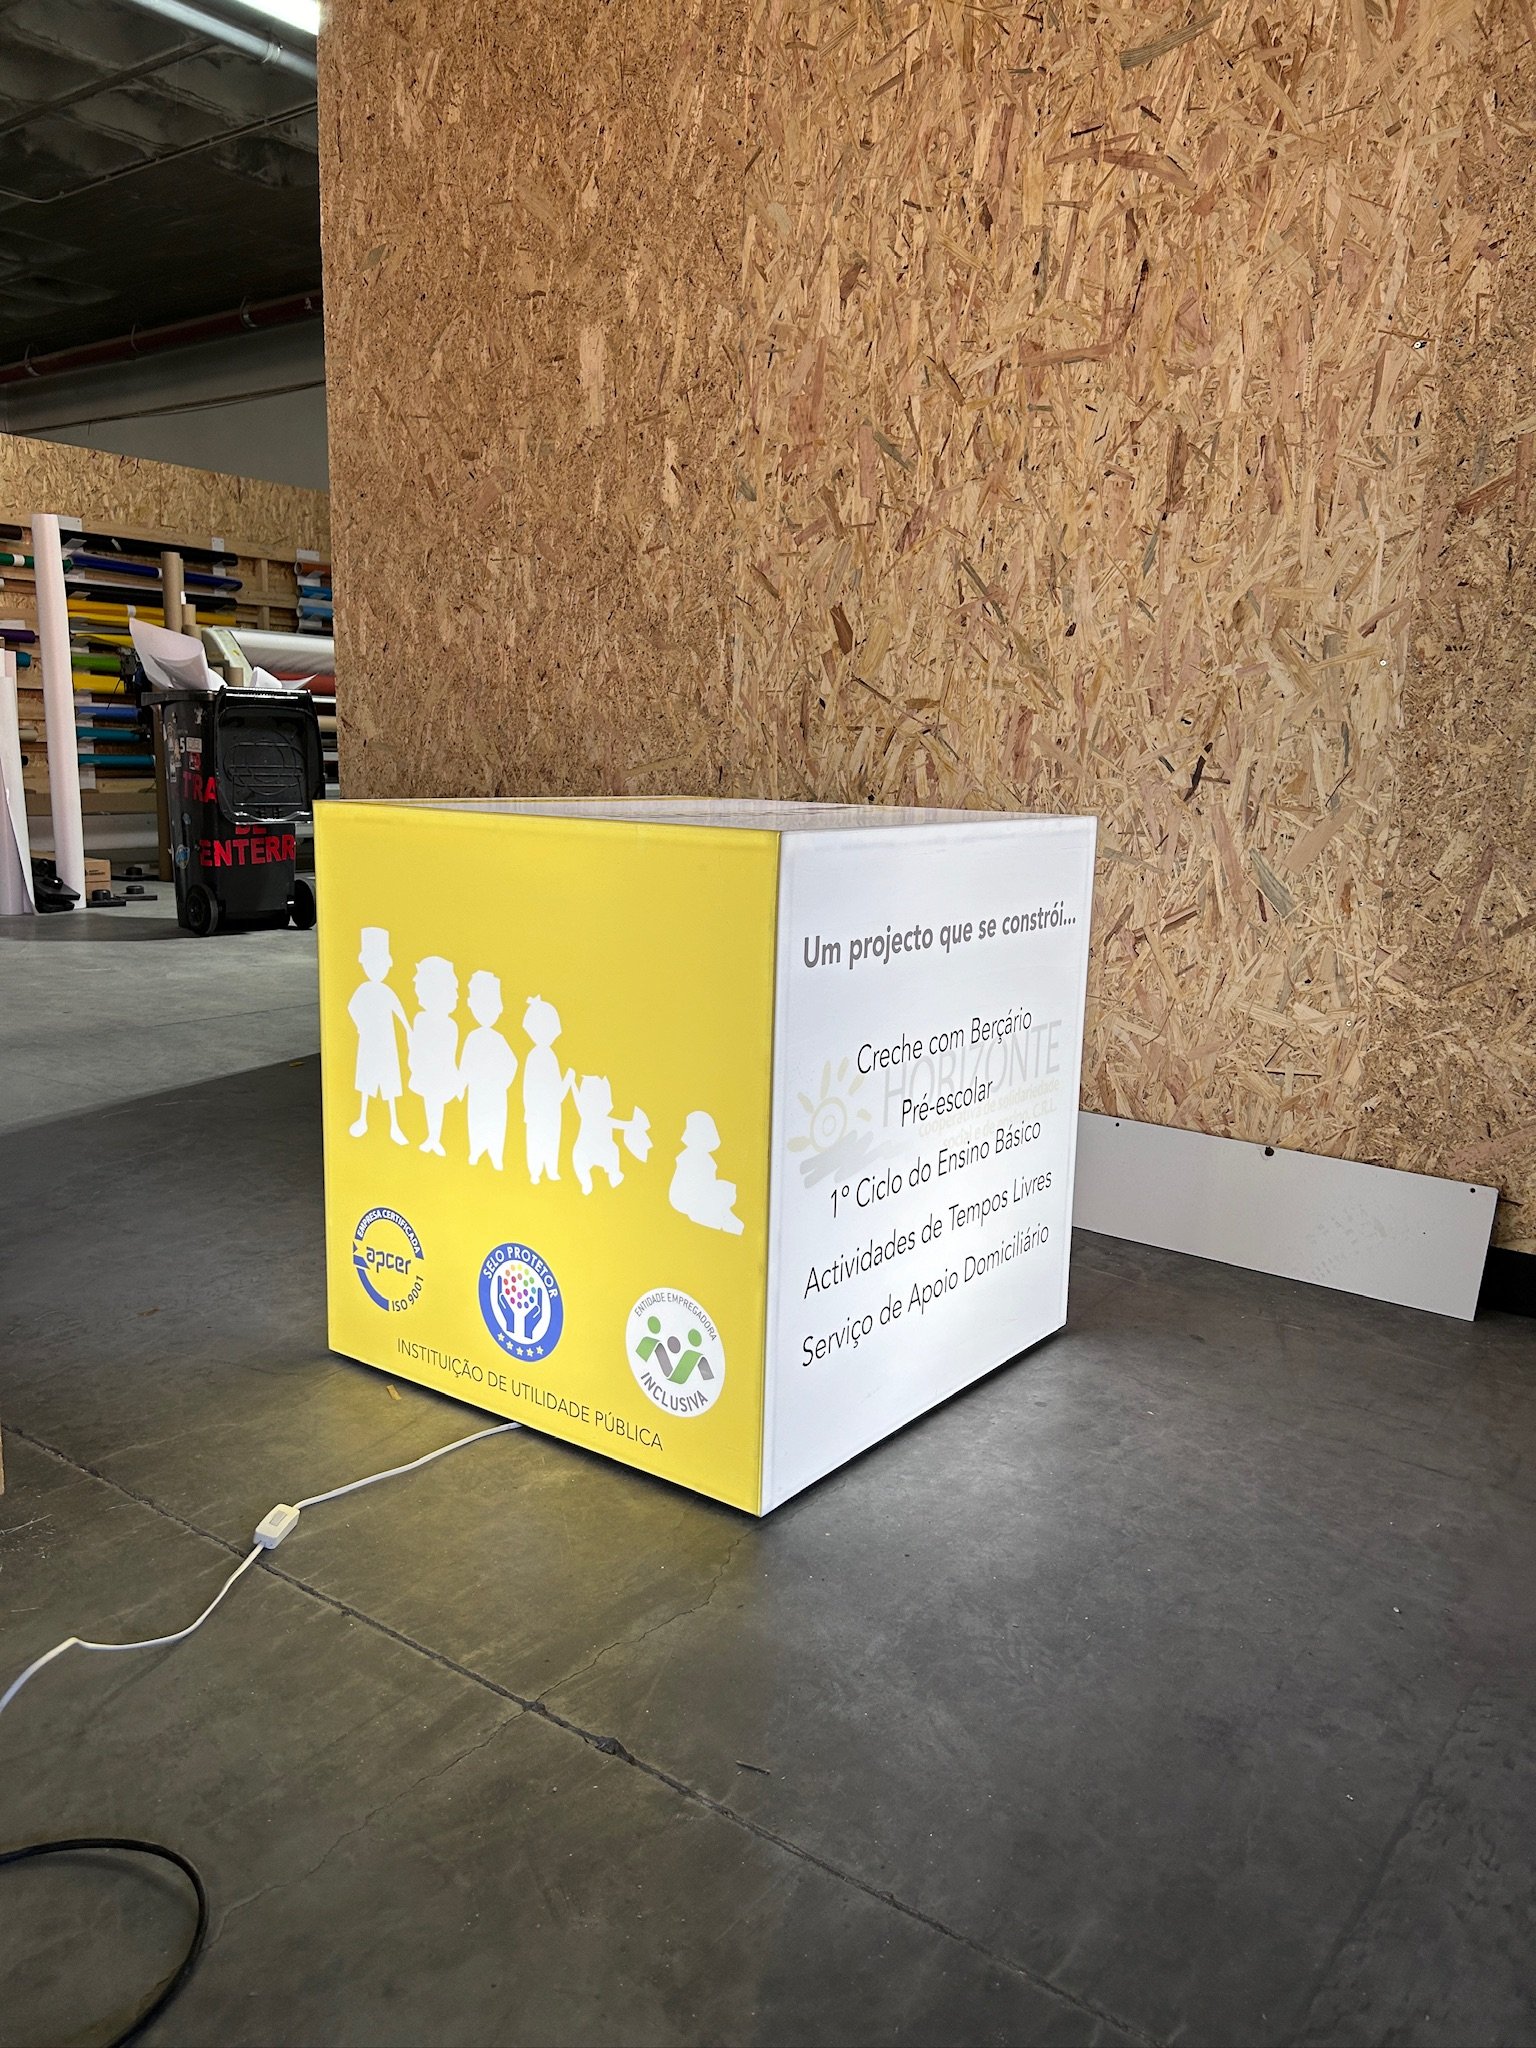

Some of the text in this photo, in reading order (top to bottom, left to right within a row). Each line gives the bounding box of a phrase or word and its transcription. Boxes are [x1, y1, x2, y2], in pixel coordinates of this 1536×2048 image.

[804, 901, 1077, 970] Um projecto que se constrói...
[857, 1006, 1033, 1074] Creche com Berçário
[883, 1020, 1063, 1128] HORIZONTE
[901, 1077, 993, 1127] Pré-escolar
[830, 1121, 1041, 1219] 1º Ciclo do Ensino Básico
[356, 1209, 420, 1254] EMPRESA CERTIFICADA
[366, 1246, 411, 1275] apcer
[804, 1171, 1053, 1299] Actividades de Tempos Livres
[391, 1275, 424, 1312] ISO 9001
[483, 1246, 558, 1298] SELO PROTETOR
[802, 1223, 1050, 1367] Serviço de Apoio Domiciliário
[634, 1292, 717, 1341] ENTIDADE EMPREGADORA
[397, 1337, 664, 1451] INSTITUIÇÃO DE UTILIDADE PÚBLICA
[640, 1371, 708, 1413] INCLUSIVA
